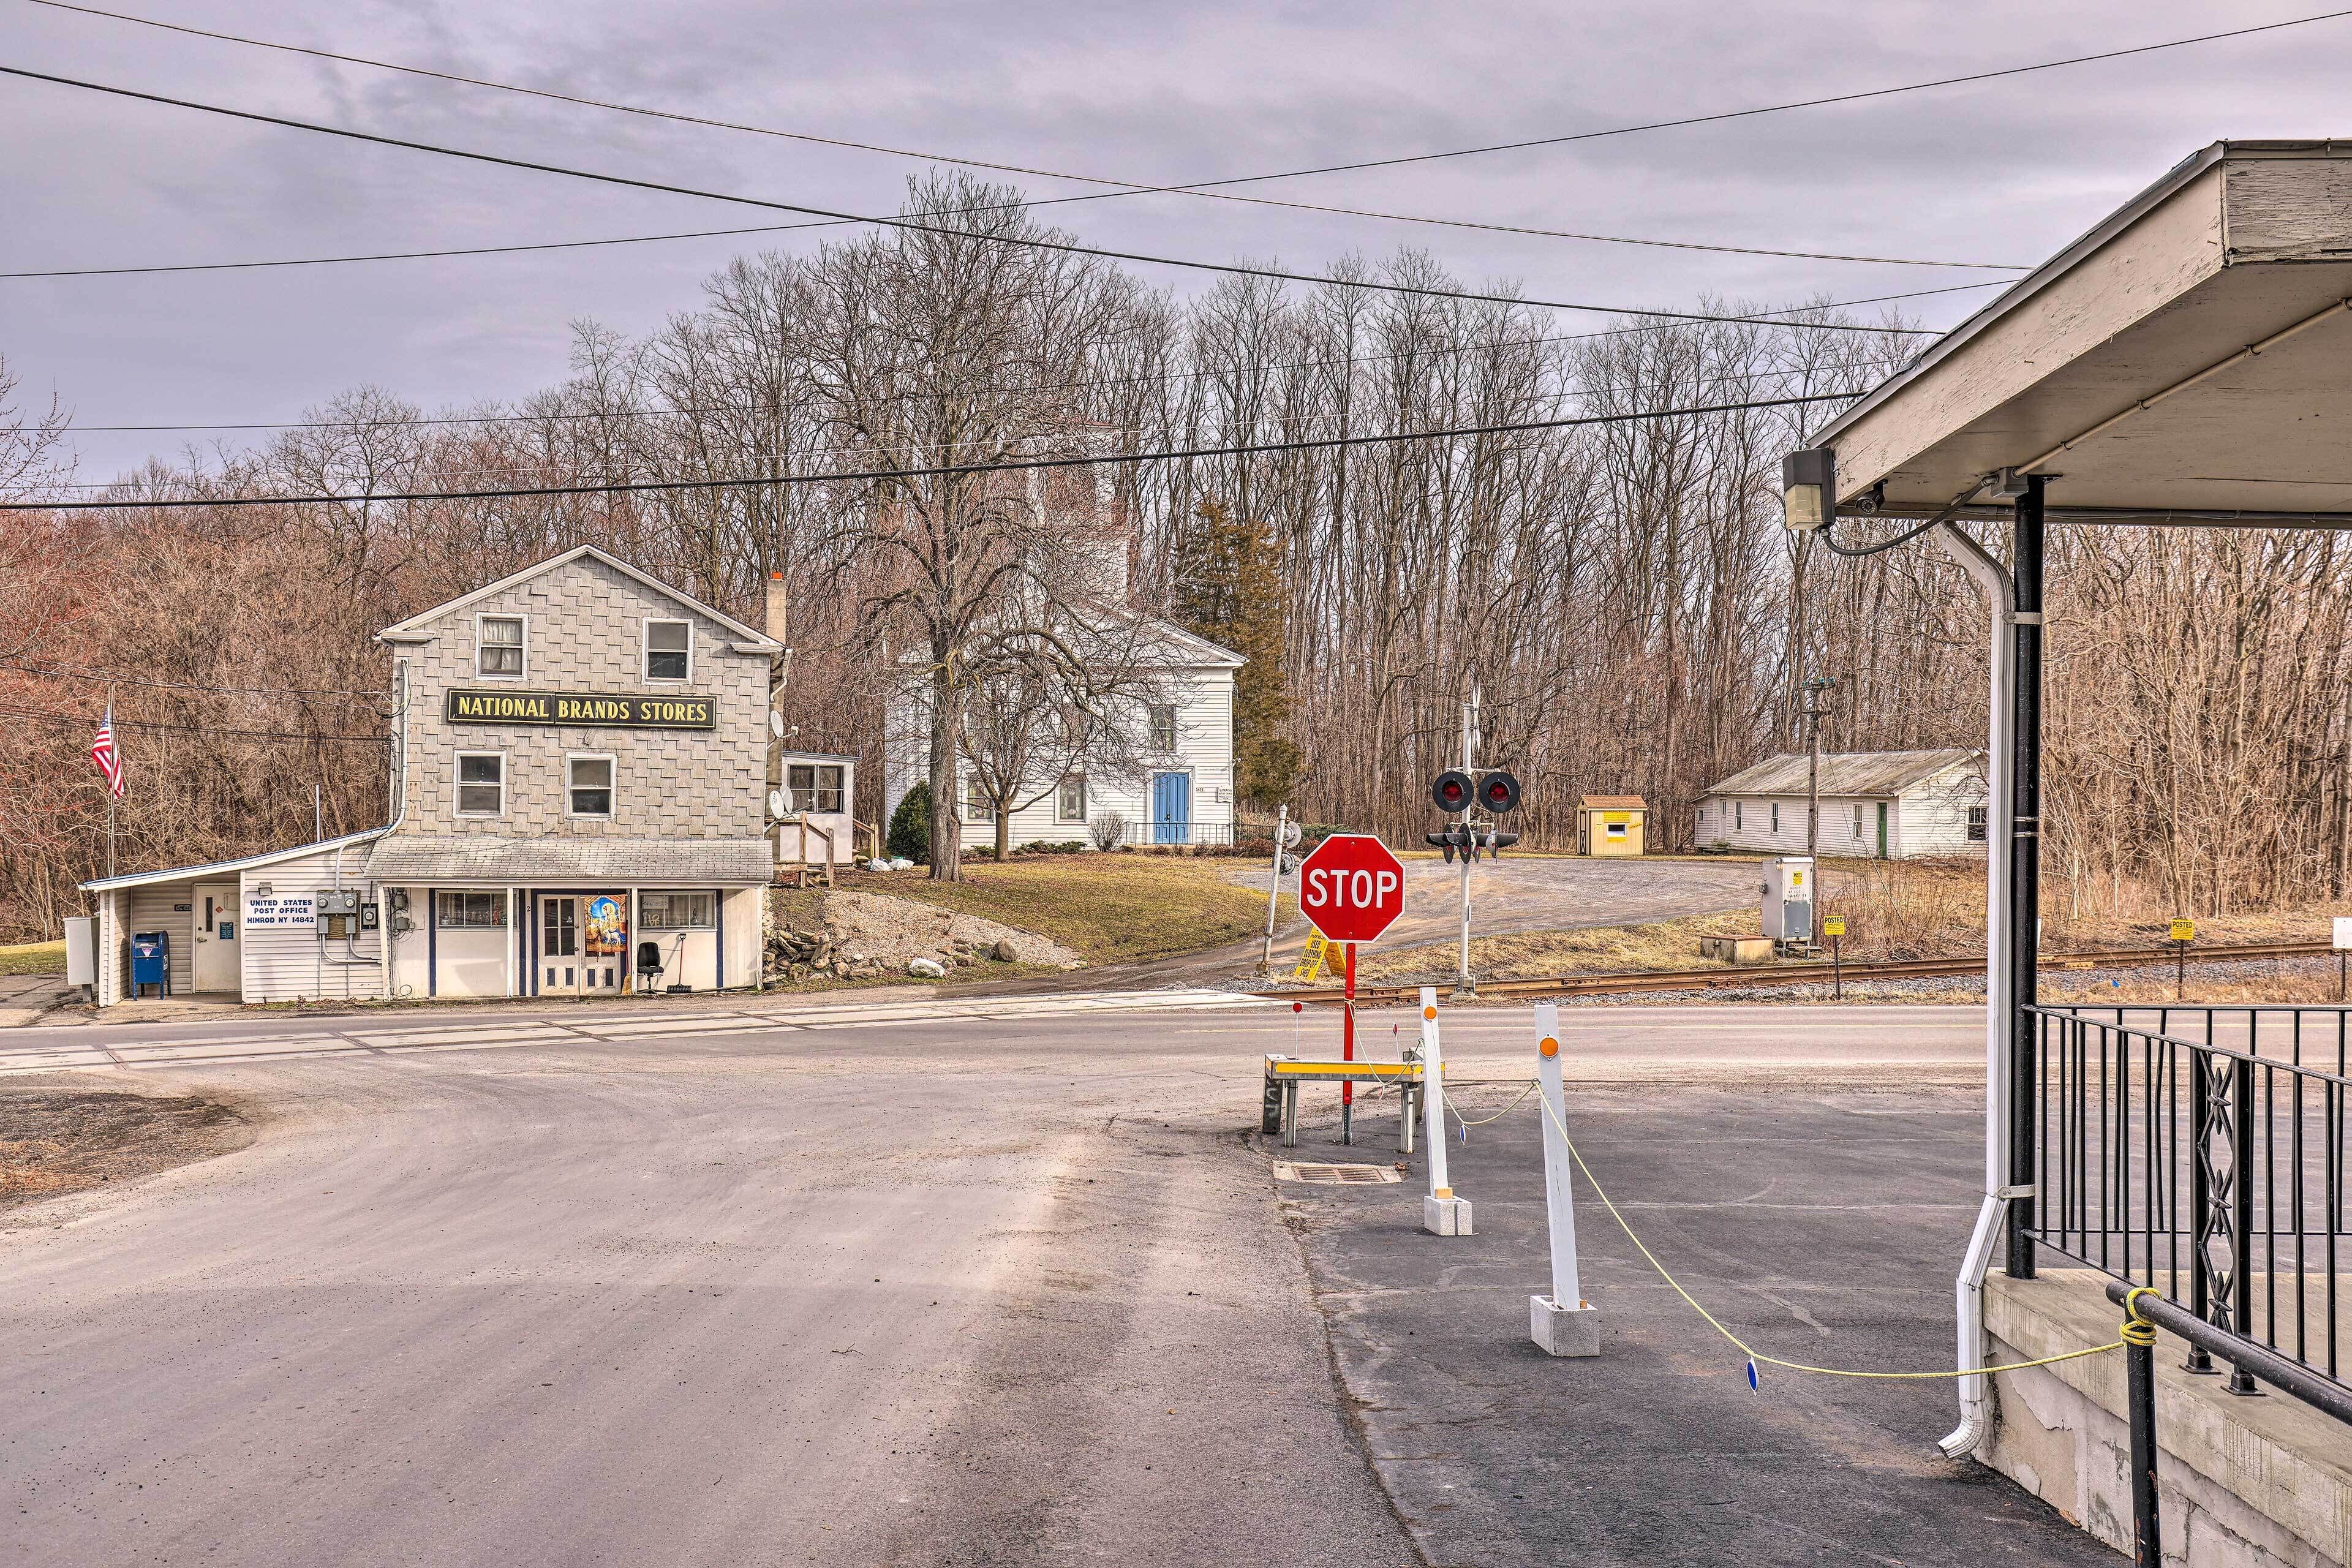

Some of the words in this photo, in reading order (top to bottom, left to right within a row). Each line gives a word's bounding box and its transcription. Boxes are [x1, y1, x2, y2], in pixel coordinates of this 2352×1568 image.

[458, 696, 549, 718] NATIONAL
[557, 700, 630, 720] BRANDS
[640, 702, 707, 722] STORES
[1306, 868, 1398, 908] STOP
[1311, 940, 1321, 949] USED
[1303, 949, 1322, 959] CLOTHING
[1299, 968, 1310, 978] SHED
